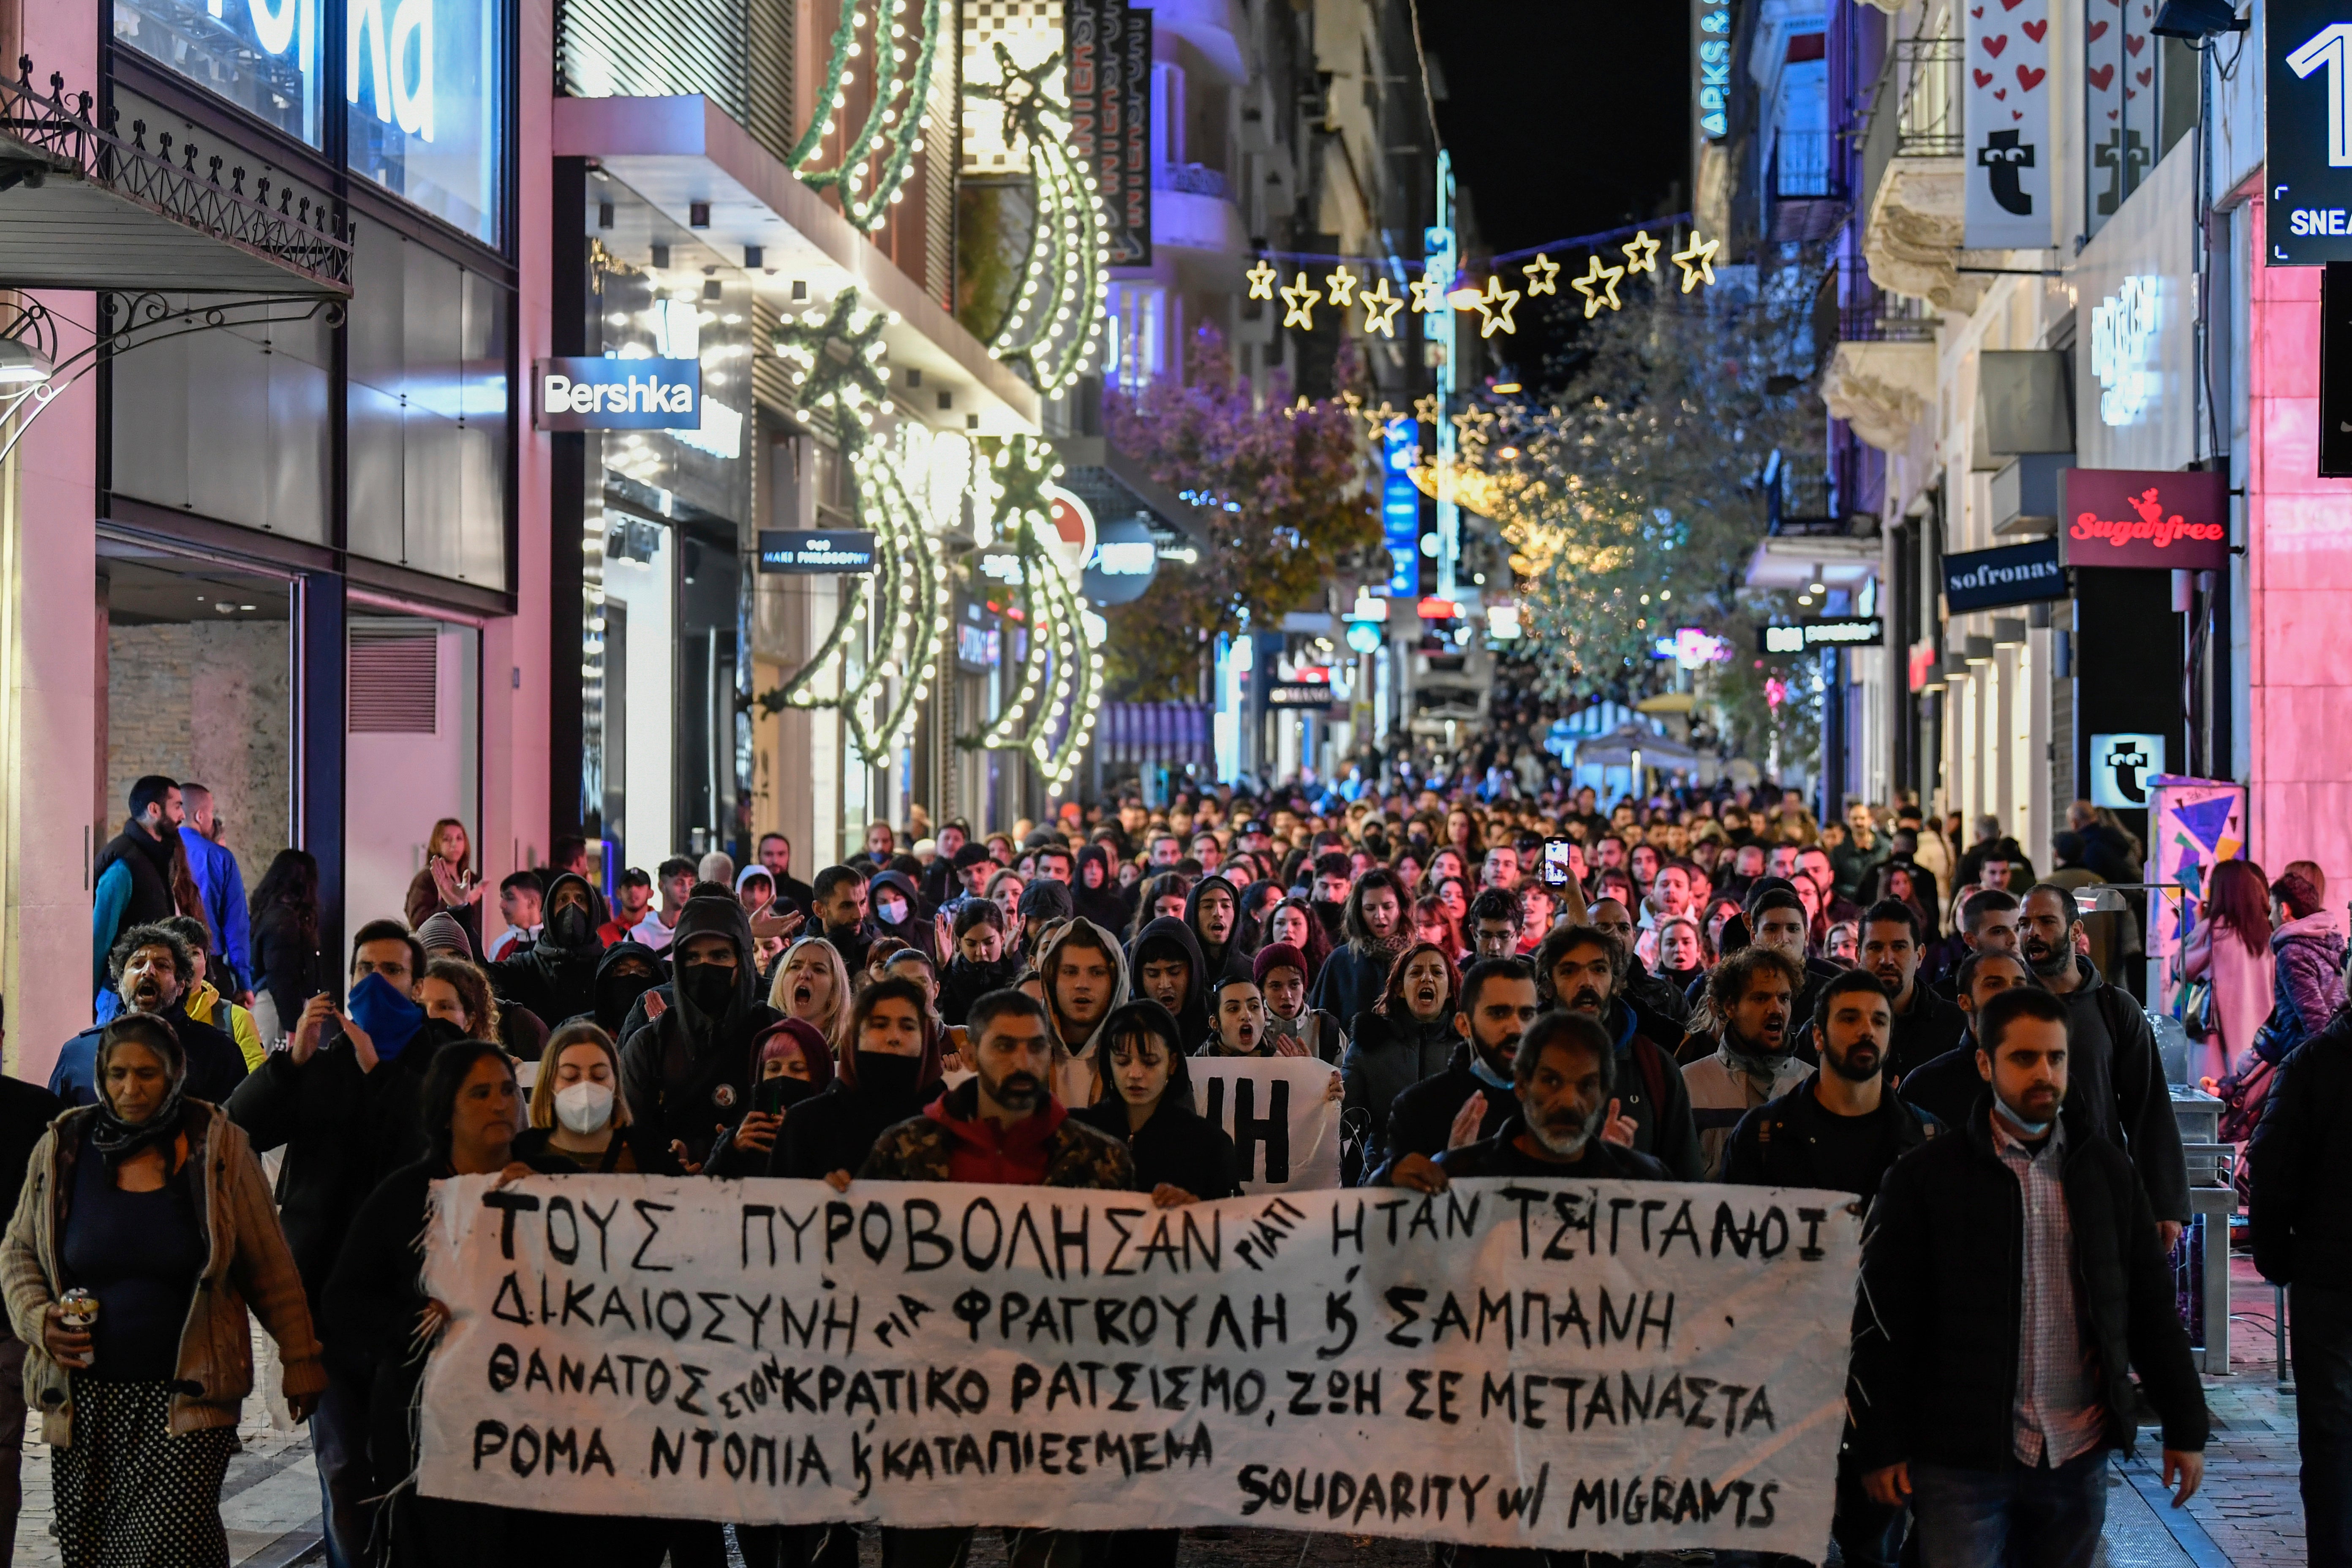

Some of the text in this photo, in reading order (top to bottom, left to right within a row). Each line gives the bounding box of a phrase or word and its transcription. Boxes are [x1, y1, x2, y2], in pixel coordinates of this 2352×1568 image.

[1701, 9, 1730, 34] &
[2290, 209, 2352, 236] SNE
[545, 375, 693, 414] Bershka
[2070, 512, 2224, 548] Sugarfree
[1950, 560, 2058, 591] sofronas
[482, 1184, 1827, 1281] ΤΟΥΣ ΠΥΡΟΒΟΛΗΣΑΝ ΓΙΑΤΙ ΗΤΑΝ ΤΣΙΓΓΑΝΟΙ
[873, 1293, 935, 1348] ΓΙΑ
[1385, 1286, 1674, 1352] ΣΑΜΠΑΝΗ
[488, 1342, 710, 1416] ΘΑΝΑΤΟΣ
[717, 1353, 782, 1420] ΣΤΟΝ
[782, 1365, 990, 1417] ΚΡΑΤΙΚΟ
[1286, 1367, 1381, 1416] ΖΩΗ
[1406, 1369, 1464, 1424] ΣΕ
[1481, 1370, 1775, 1438] ΜΕΤΑΝΑΣΤΑ
[473, 1419, 615, 1478] ΡΟΜΑ
[651, 1426, 832, 1487] ΝΤΟΠΙΑ
[882, 1421, 1213, 1481] ΚΑΤΑΠΙΕΣΜΕΝΑ
[1238, 1463, 1489, 1526] SOLIDARITY
[1568, 1475, 1779, 1529] MIGRANTS
